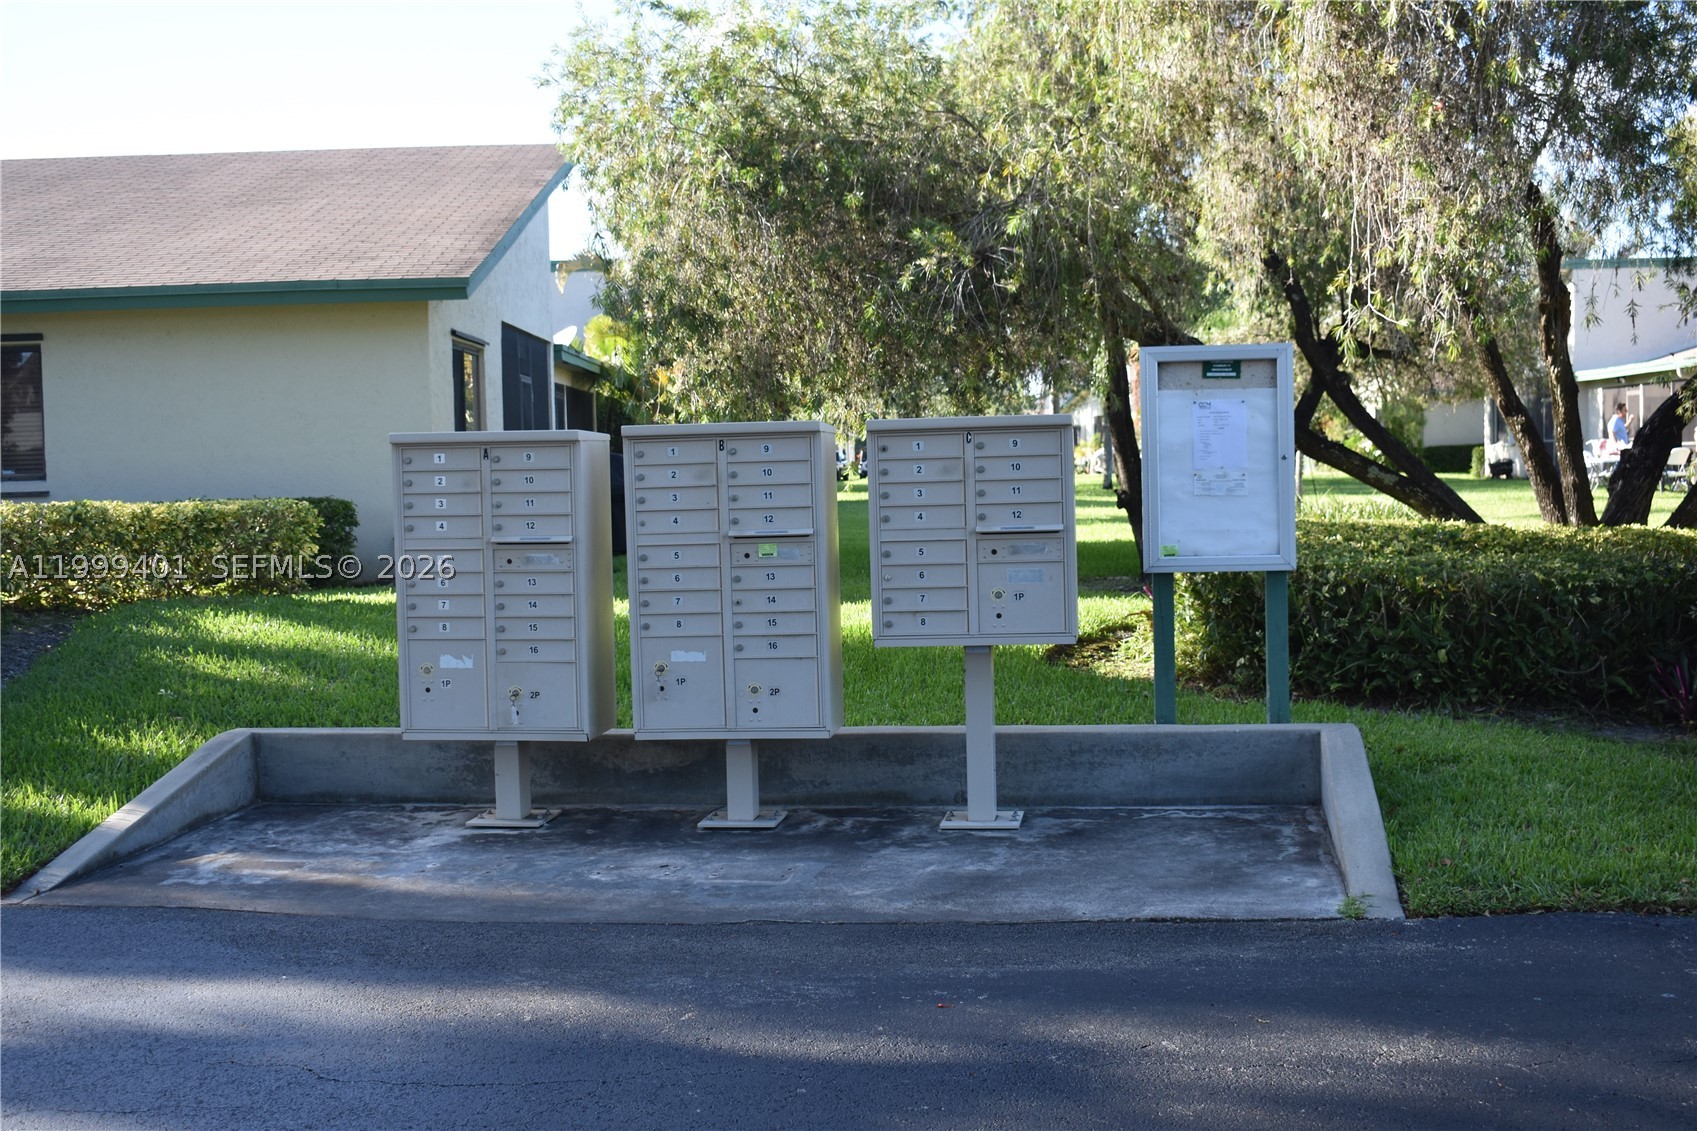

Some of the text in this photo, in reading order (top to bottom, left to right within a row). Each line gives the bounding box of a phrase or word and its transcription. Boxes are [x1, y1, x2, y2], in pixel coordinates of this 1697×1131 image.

[966, 432, 972, 443] C
[719, 440, 725, 451] B
[1012, 439, 1018, 448] 9
[763, 445, 770, 453] 9
[483, 448, 489, 460] A
[916, 465, 922, 474] 2
[1010, 463, 1021, 471] 10
[762, 468, 772, 476] 10
[917, 489, 923, 497] 3
[1012, 486, 1021, 494] 11
[672, 494, 678, 502] 3
[1012, 510, 1022, 519] 12
[674, 551, 680, 560] 5
[674, 574, 680, 582] 6
[766, 572, 776, 581] 13
[919, 571, 925, 579] 6
[440, 578, 446, 587] 6
[1014, 593, 1024, 601] 1P
[768, 618, 777, 627] 15
[920, 618, 926, 626] 8
[768, 641, 778, 650] 16
